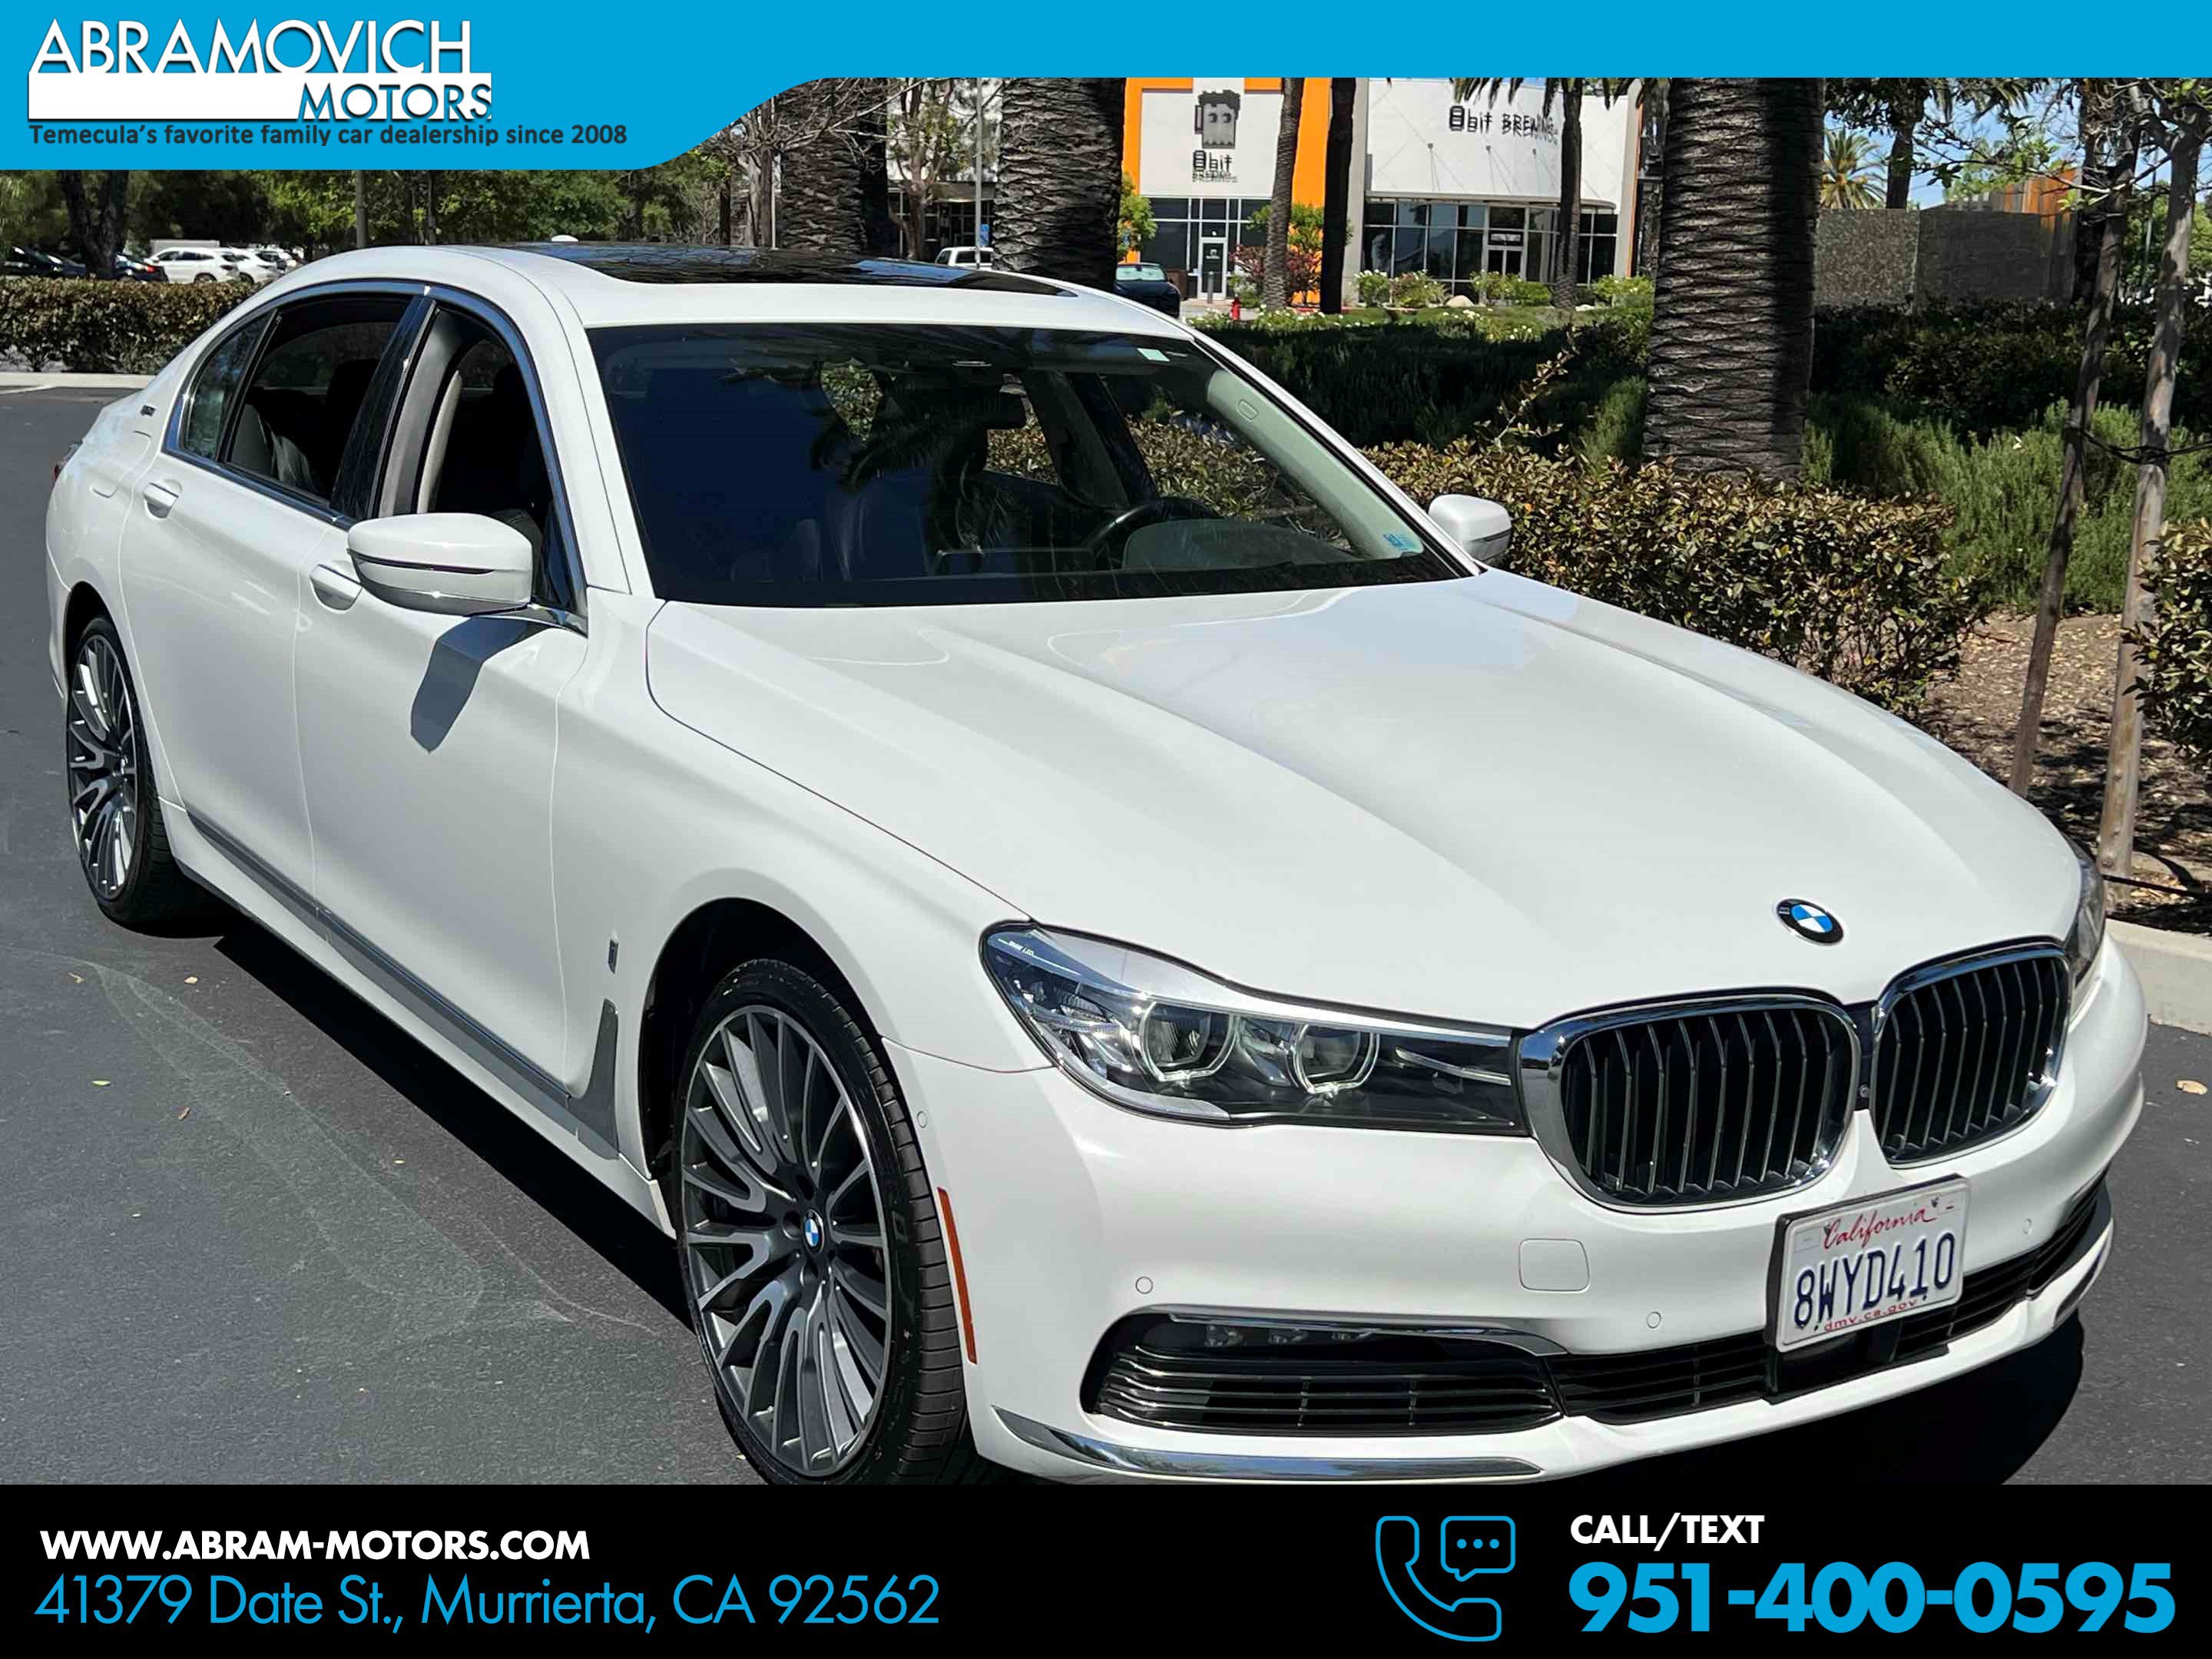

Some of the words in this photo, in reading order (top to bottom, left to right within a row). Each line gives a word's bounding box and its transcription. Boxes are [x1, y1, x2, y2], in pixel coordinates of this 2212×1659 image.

[1823, 1208, 1936, 1250] California
[1794, 1232, 1955, 1328] 8WYD410
[1825, 1300, 1917, 1331] dmv.ca.gov
